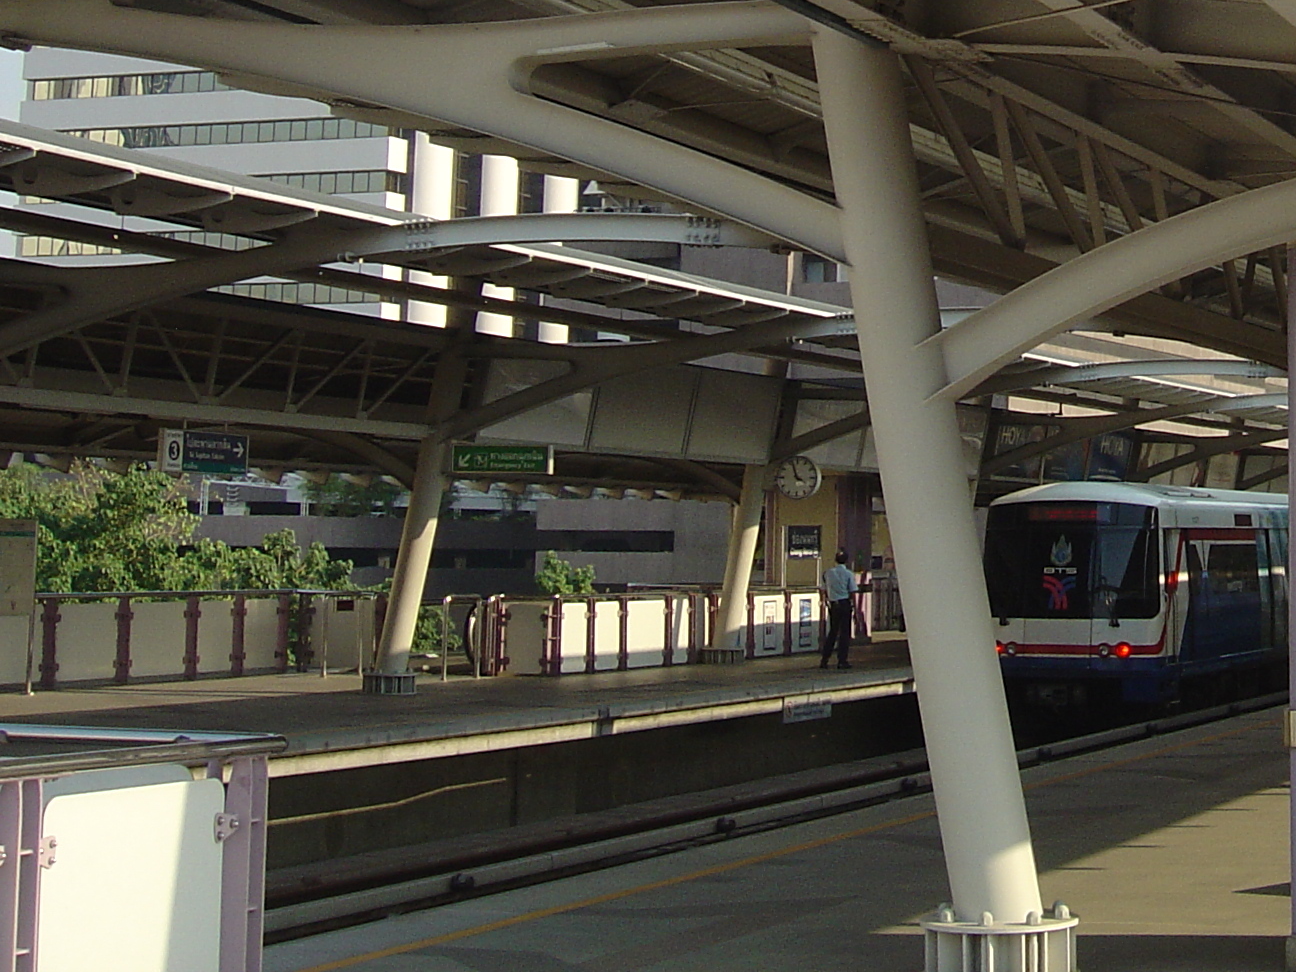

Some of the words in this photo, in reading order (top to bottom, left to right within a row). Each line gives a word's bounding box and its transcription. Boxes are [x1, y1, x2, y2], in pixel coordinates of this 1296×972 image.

[1001, 425, 1025, 445] HOYA
[170, 442, 178, 460] 3
[1100, 435, 1125, 456] HOYA
